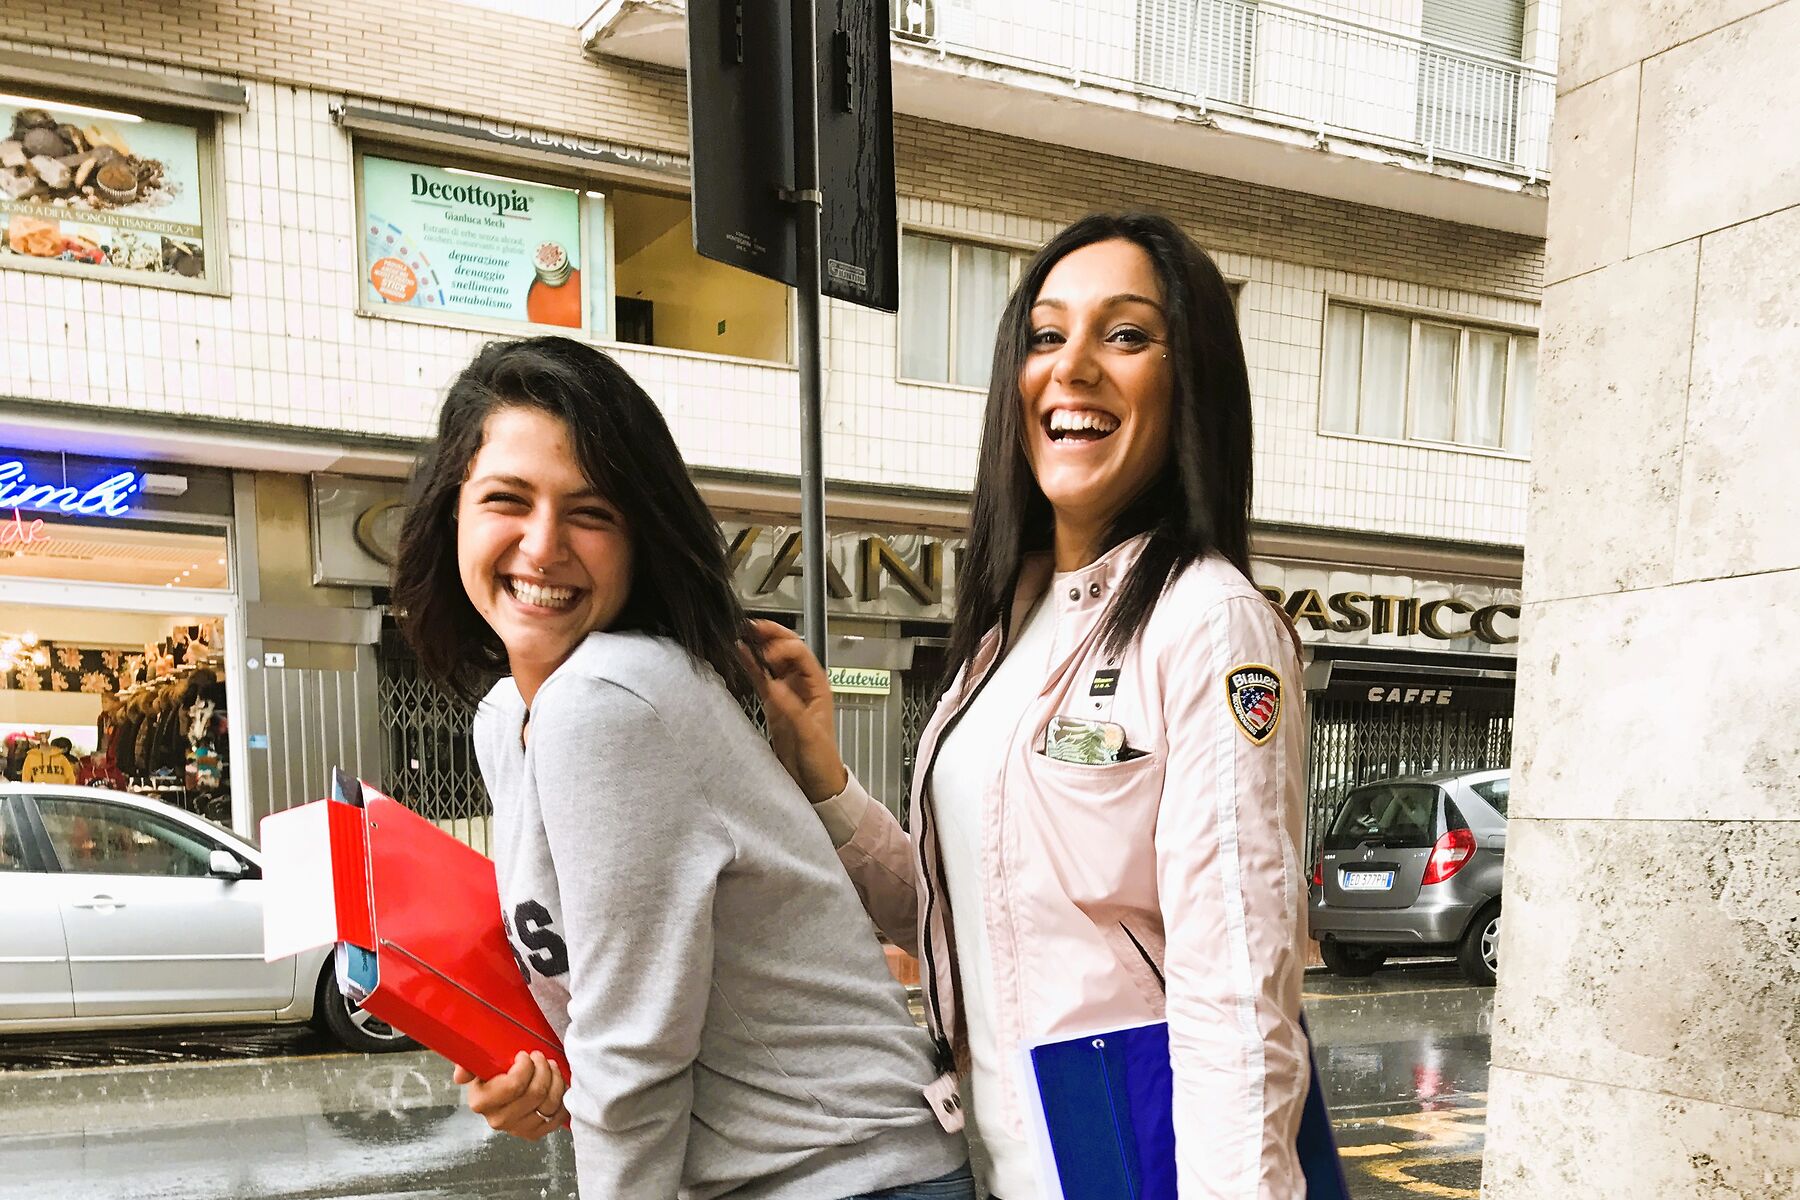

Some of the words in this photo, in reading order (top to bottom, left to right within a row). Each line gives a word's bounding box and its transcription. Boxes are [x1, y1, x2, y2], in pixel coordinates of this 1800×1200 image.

[411, 173, 530, 215] Decottopia
[445, 211, 481, 225] Gianluca
[484, 216, 505, 229] Mech
[448, 250, 510, 267] depurazione
[454, 265, 505, 281] drenaggio
[451, 280, 509, 295] snellimento
[449, 294, 512, 310] metabolismo
